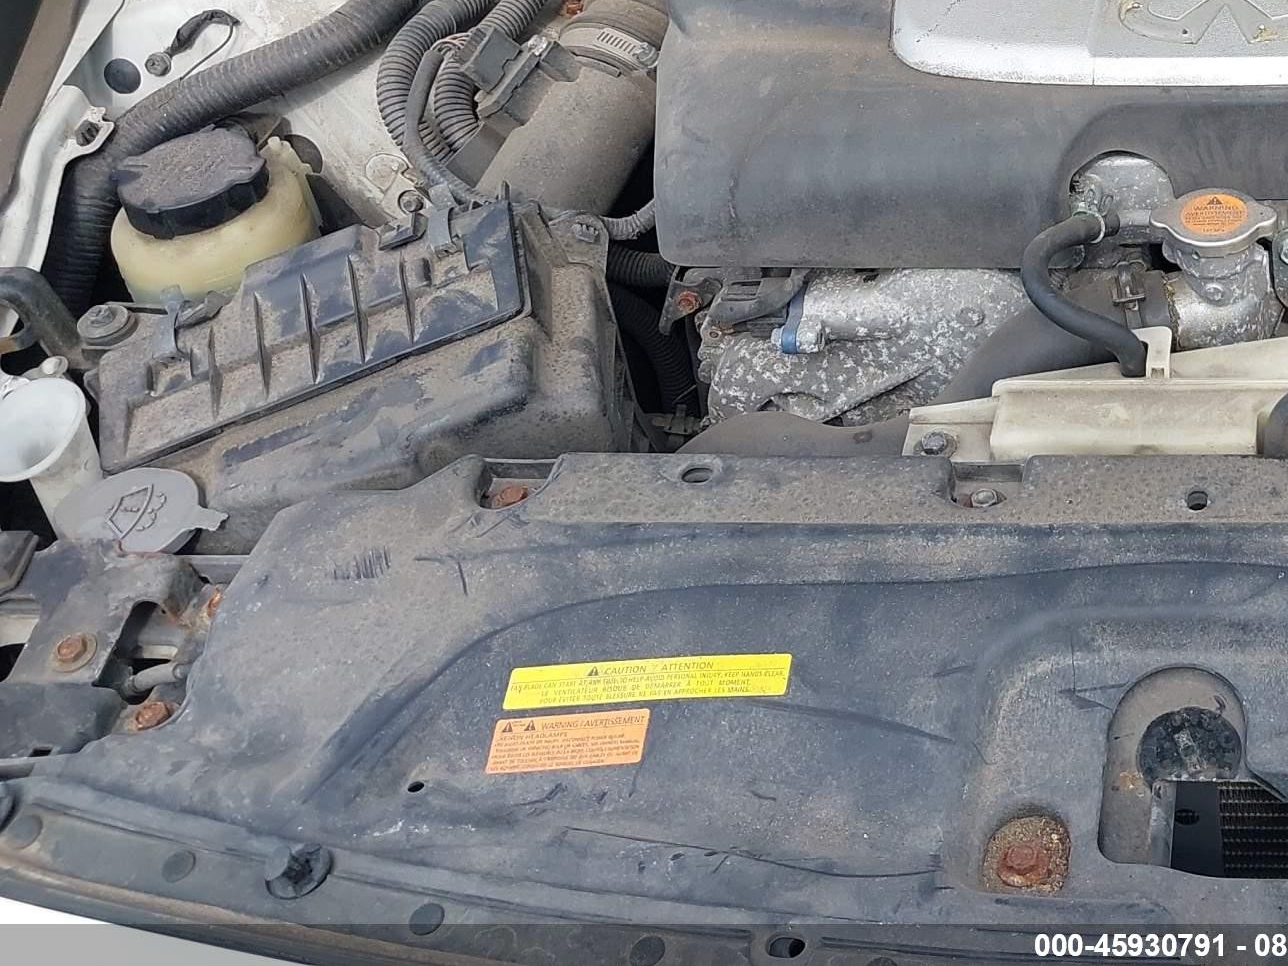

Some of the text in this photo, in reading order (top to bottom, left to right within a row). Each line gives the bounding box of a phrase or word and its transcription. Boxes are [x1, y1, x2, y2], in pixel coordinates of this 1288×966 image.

[604, 665, 647, 675] CAUTION
[661, 661, 715, 671] ATTENTION
[667, 673, 697, 681] PERSONAL
[541, 720, 579, 730] WARNING
[584, 715, 646, 728] AVERTISSEMENT
